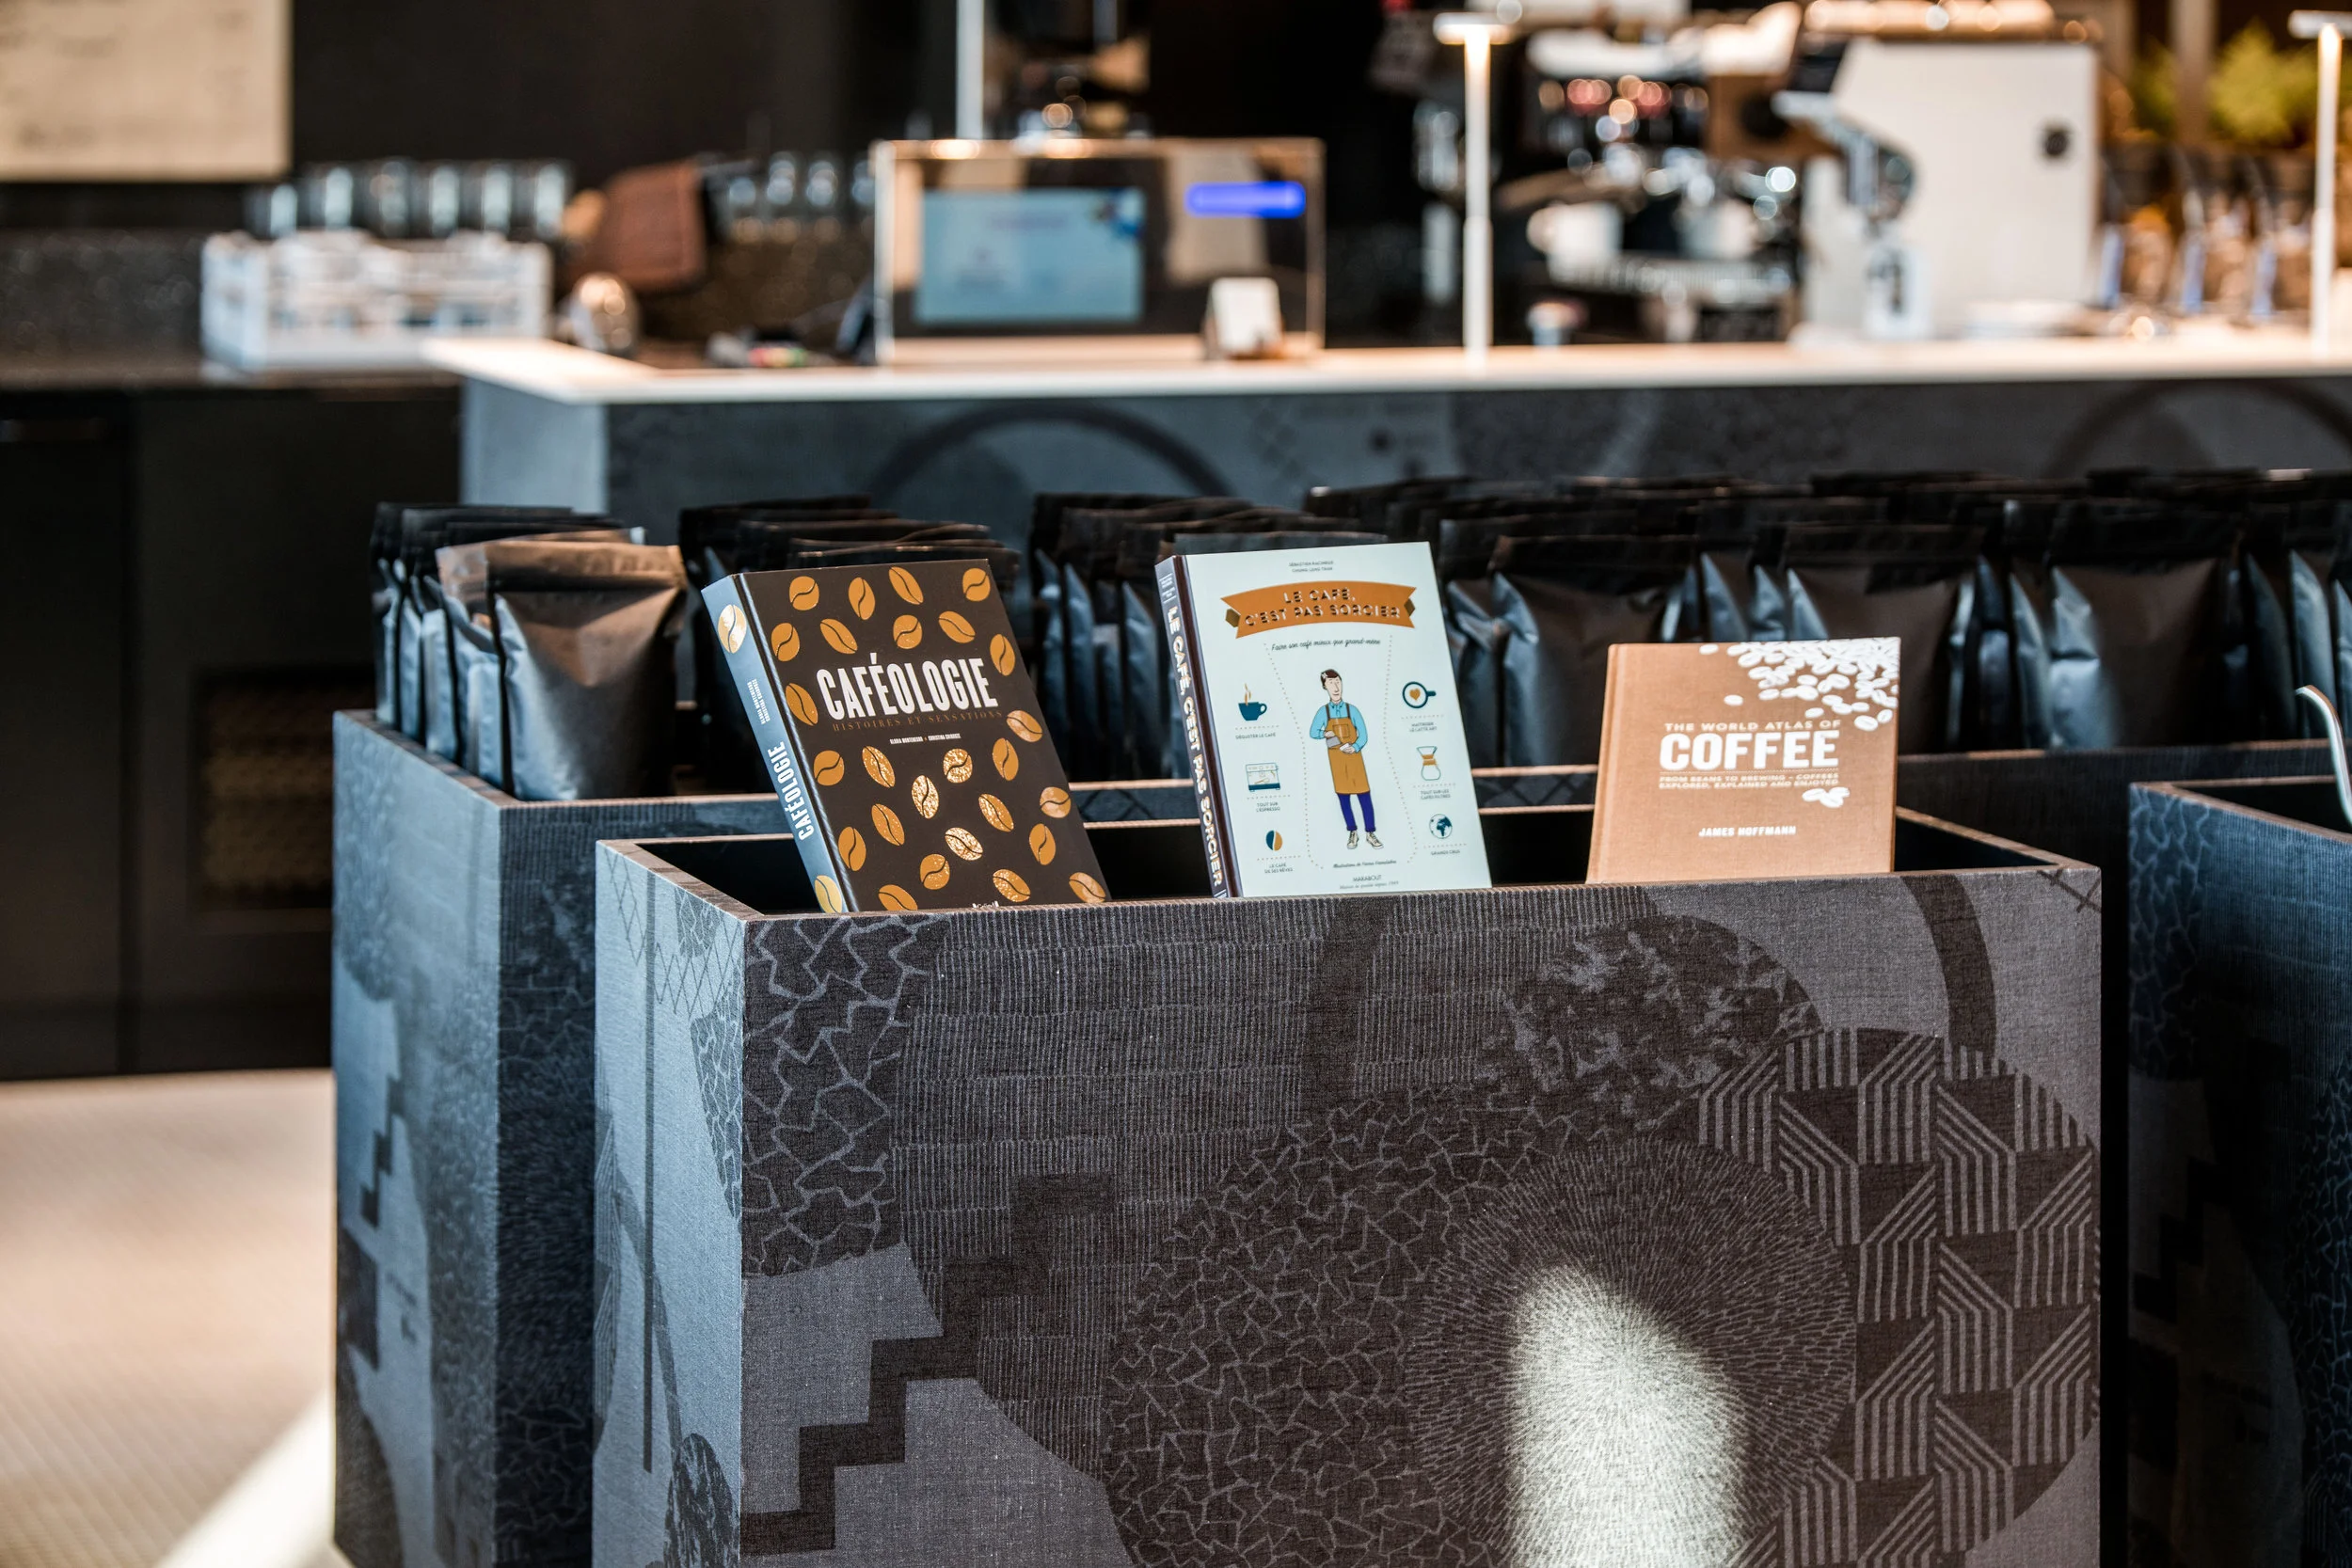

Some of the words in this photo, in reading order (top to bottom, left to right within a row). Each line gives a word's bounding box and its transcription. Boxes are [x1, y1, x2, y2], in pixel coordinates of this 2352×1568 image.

[1283, 591, 1303, 604] LE
[1309, 587, 1356, 601] CAFÉ,
[1168, 606, 1181, 635] LE
[1245, 608, 1287, 626] C'EST
[1294, 605, 1324, 619] PAS
[1329, 604, 1401, 619] SORCIER
[816, 652, 999, 721] CAFÉOLOGIE
[832, 719, 901, 732] HISTOIRES
[908, 716, 922, 725] ET
[929, 710, 1003, 723] SENSATIONS
[1184, 696, 1201, 752] C'EST
[1664, 722, 1694, 732] THE
[1701, 721, 1759, 732] WORLD
[1764, 721, 1814, 730] ATLAS
[1819, 720, 1842, 728] OF
[1659, 730, 1840, 771] COFFEE
[1193, 753, 1208, 795] PAS
[1793, 779, 1839, 787] ENJOYED
[767, 741, 815, 841] CAFÉOLOGIE
[1200, 796, 1223, 887] SORCIER
[1698, 827, 1735, 837] JAMES
[1738, 826, 1796, 836] HOFFMANN
